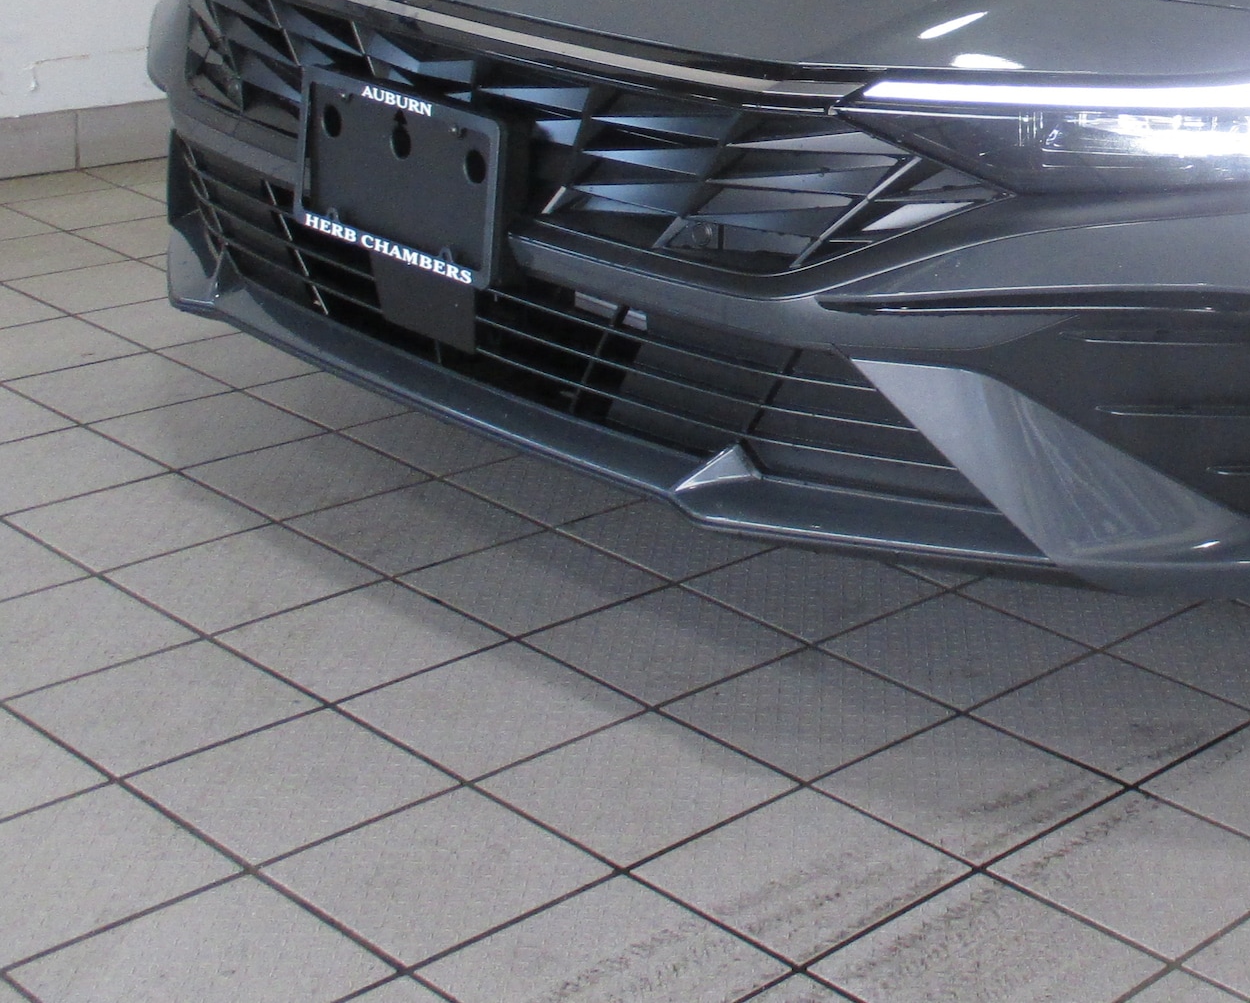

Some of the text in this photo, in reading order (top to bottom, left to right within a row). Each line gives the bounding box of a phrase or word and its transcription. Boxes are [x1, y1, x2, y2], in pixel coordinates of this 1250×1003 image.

[361, 85, 433, 117] AUBURN
[304, 213, 473, 284] HERB CHAMBERS
